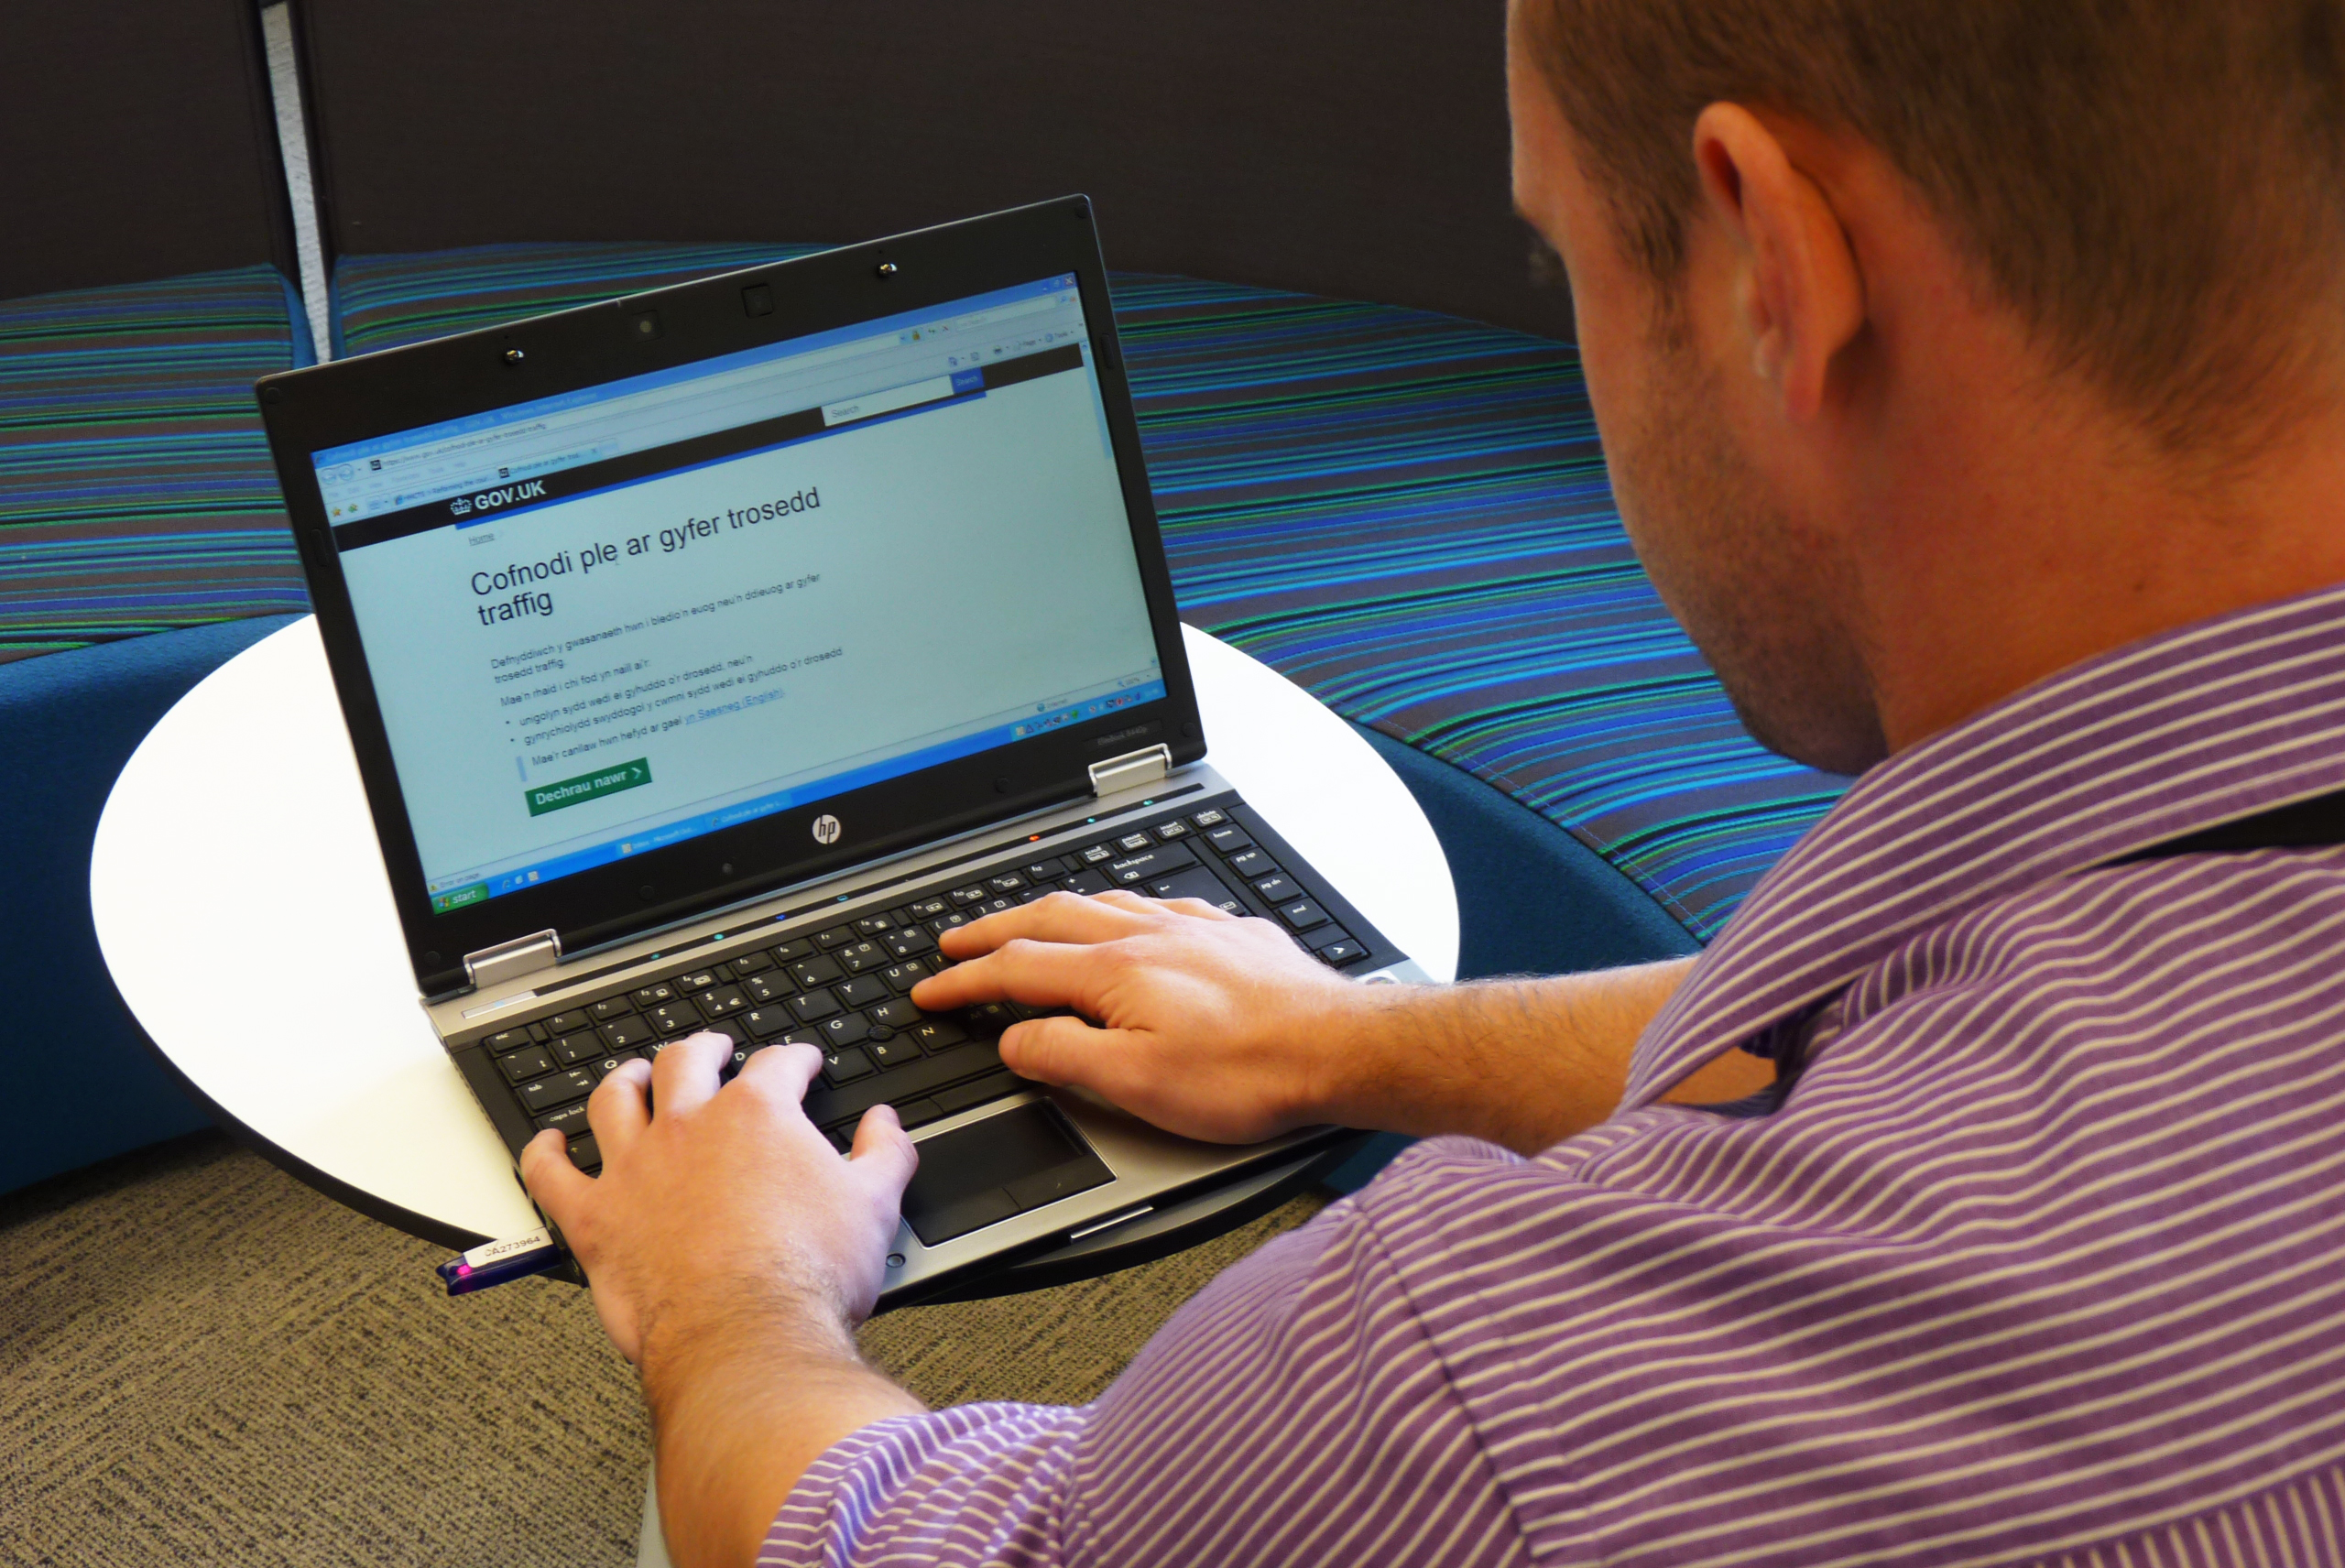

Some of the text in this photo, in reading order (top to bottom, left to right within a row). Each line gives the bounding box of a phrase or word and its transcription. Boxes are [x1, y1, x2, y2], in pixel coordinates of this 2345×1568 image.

[831, 405, 859, 418] Search
[474, 480, 546, 509] GOV.UK
[467, 531, 496, 546] Home
[471, 485, 820, 595] Cofnodi ple ar gyfer trosedd
[477, 591, 552, 626] traffig
[490, 644, 554, 669] Defnyddiwch
[556, 643, 562, 653] y
[564, 626, 622, 651] gwasanaeth
[623, 621, 644, 632] hwn
[650, 609, 688, 626] bledio'n
[690, 602, 715, 615] euog
[716, 594, 742, 606] neu'n
[744, 583, 783, 600] ddieuog
[784, 581, 793, 589] ar
[796, 573, 820, 588] gyfer
[494, 665, 533, 683] trosedd
[500, 692, 529, 706] Mae'n
[532, 683, 557, 696] rhaid
[563, 679, 579, 689] chi
[580, 672, 597, 683] fod
[598, 670, 612, 681] yn
[612, 662, 632, 675] naill
[519, 709, 560, 725] unigolyn
[562, 700, 586, 714] sydd
[587, 693, 611, 706] wedi
[613, 691, 622, 700] ei
[624, 680, 666, 699] gyhuddo
[726, 655, 752, 667] neu'n
[524, 717, 591, 746] gynrychiolydd
[592, 702, 645, 724] swyddogol
[646, 702, 652, 712] y
[654, 692, 685, 707] cwmni
[686, 683, 711, 698] sydd
[712, 678, 734, 690] wedi
[747, 663, 788, 683] gyhuddo
[803, 647, 843, 665] drosedd
[531, 752, 559, 765] Mae'r
[562, 742, 596, 757] canllaw
[598, 735, 618, 746] hwn
[619, 725, 648, 740] hefyd
[649, 724, 659, 733] ar
[661, 715, 682, 731] gael
[683, 713, 698, 725] yn
[697, 701, 742, 721] Saesneg
[535, 770, 626, 804] Dechrau nawr
[816, 814, 837, 844] hp
[1113, 855, 1153, 869] backspace
[1245, 852, 1256, 860] up
[1260, 880, 1273, 888] pg
[453, 889, 475, 903] start
[889, 968, 899, 976] U
[798, 996, 804, 1005] T
[750, 1012, 759, 1020] R
[878, 1007, 888, 1016] H
[665, 1019, 674, 1028] 3
[830, 1020, 842, 1029] G
[922, 1027, 933, 1035] N
[616, 1035, 626, 1043] 2
[784, 1035, 793, 1045] F
[735, 1052, 747, 1062] D
[828, 1056, 837, 1064] V
[605, 1060, 619, 1071] Q
[527, 1083, 542, 1092] tab
[550, 1106, 584, 1121] caps lock
[485, 1236, 540, 1257] CA273964
